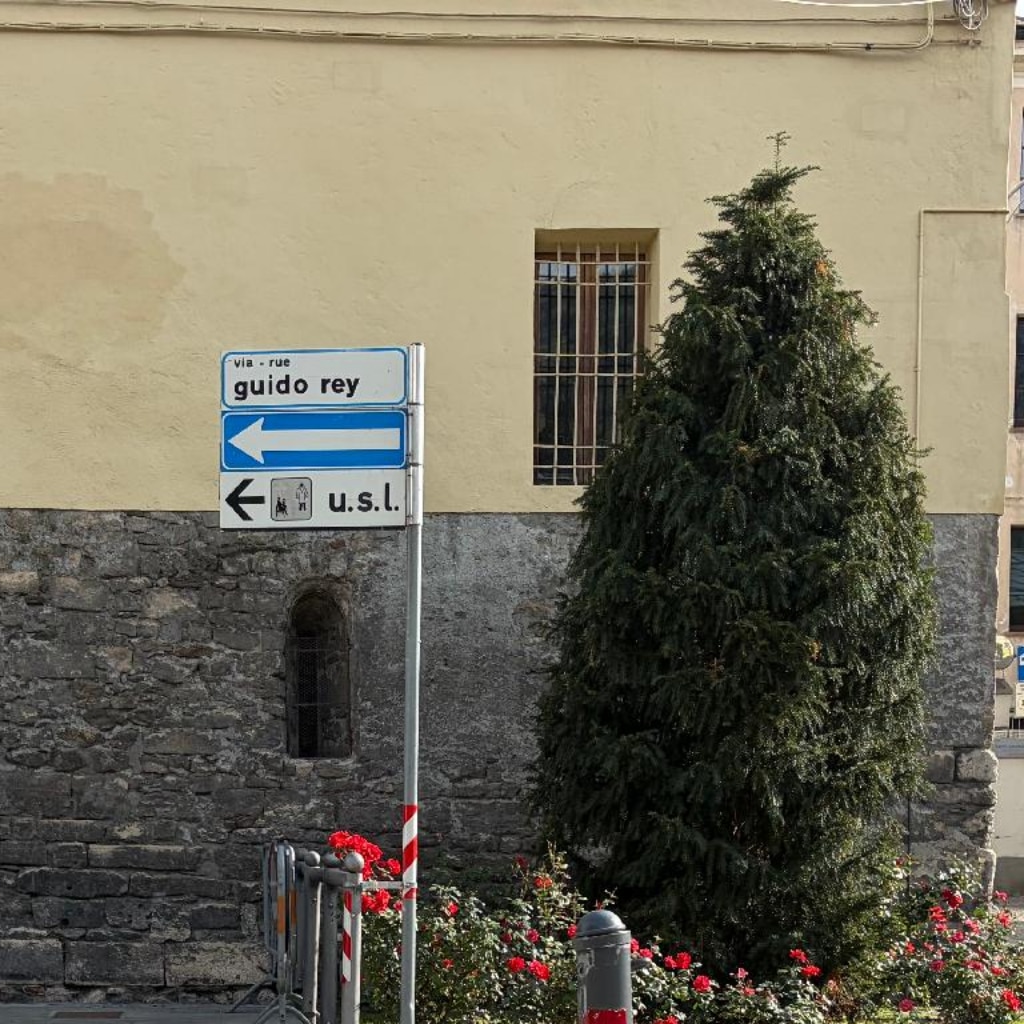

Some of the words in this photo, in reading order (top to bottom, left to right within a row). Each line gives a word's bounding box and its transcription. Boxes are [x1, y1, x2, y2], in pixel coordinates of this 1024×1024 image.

[234, 357, 253, 368] via
[269, 358, 291, 368] rue
[234, 374, 308, 401] guido
[320, 377, 360, 398] rey
[329, 482, 399, 512] u.s.l.
